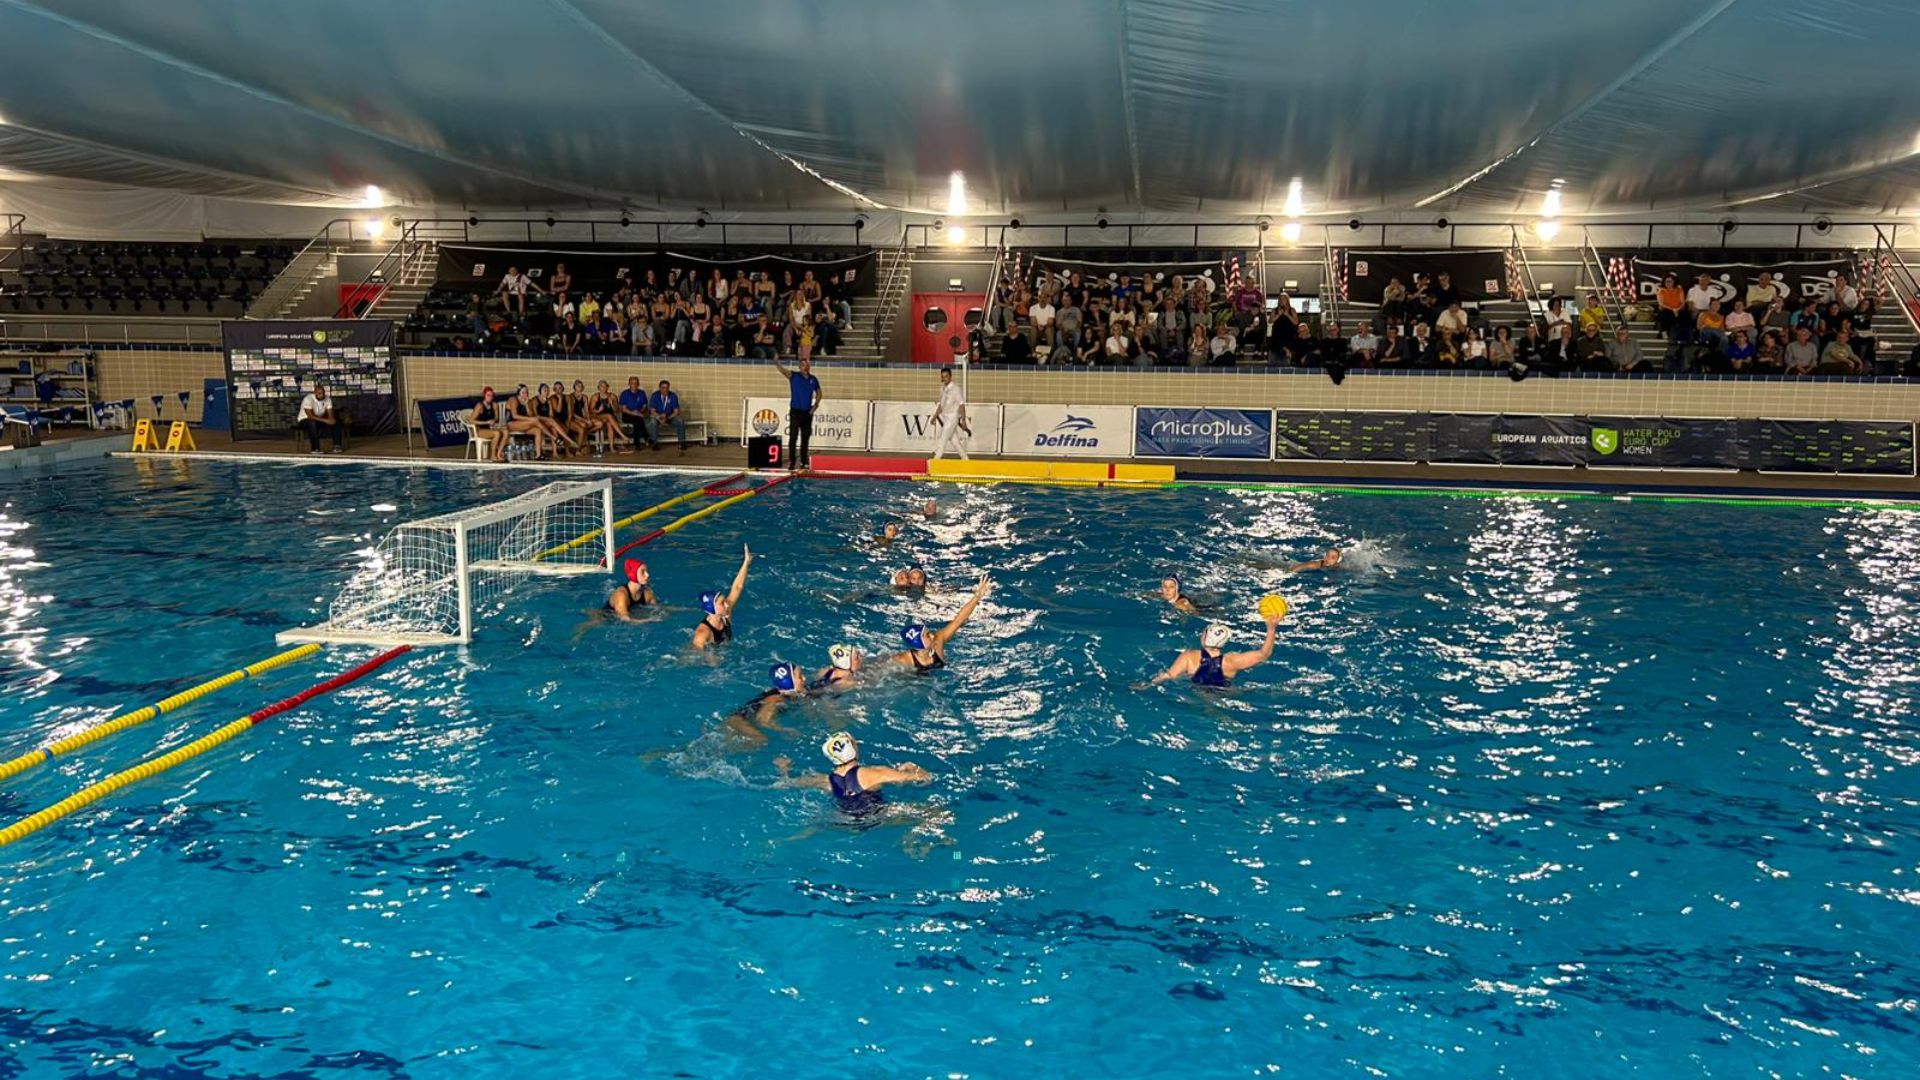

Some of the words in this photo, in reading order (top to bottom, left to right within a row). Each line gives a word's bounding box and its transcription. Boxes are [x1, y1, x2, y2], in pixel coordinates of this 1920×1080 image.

[1492, 433, 1536, 443] EUROPEAN
[1541, 435, 1587, 444] AQUATICS
[1623, 429, 1652, 438] WATER
[1034, 433, 1098, 447] Delfina
[1623, 438, 1646, 446] EURO
[1652, 438, 1669, 446] CUP
[768, 445, 779, 462] 9
[1623, 446, 1652, 454] WOMEN
[905, 628, 919, 640] 12
[774, 667, 788, 679] 10
[832, 740, 845, 752] 12
